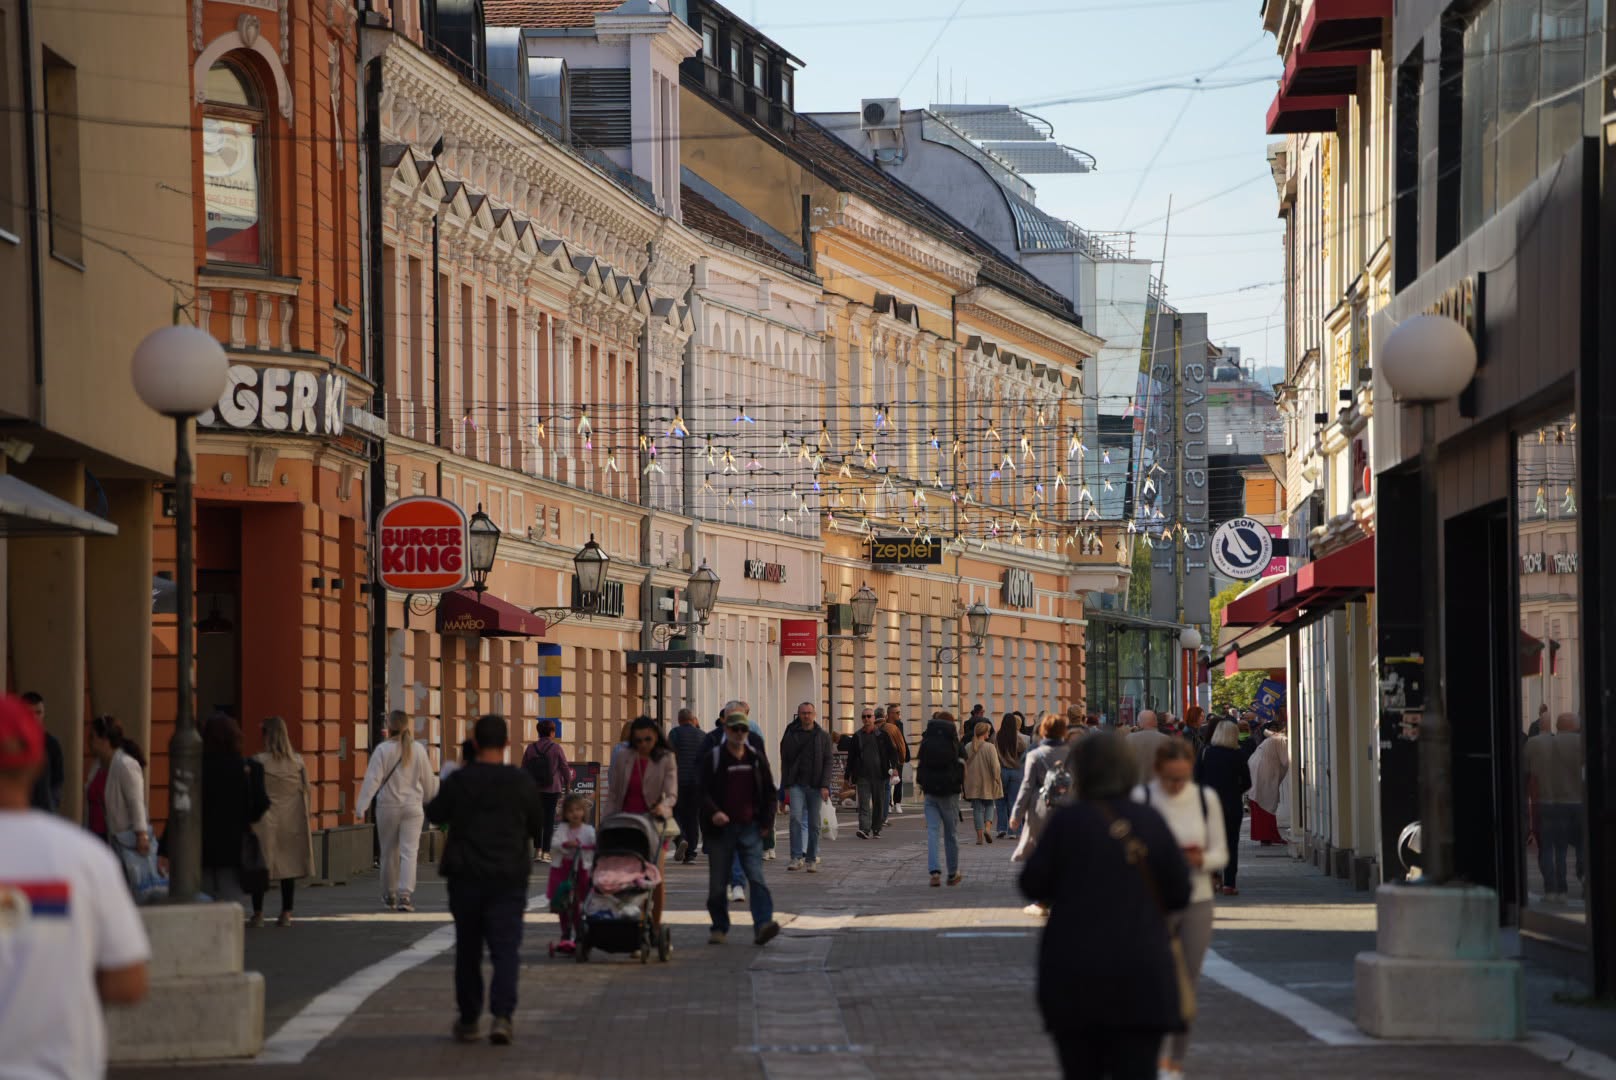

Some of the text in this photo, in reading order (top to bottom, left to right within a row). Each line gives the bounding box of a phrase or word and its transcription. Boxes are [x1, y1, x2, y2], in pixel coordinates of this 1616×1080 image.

[196, 364, 318, 433] GER
[1228, 520, 1255, 529] LEON
[381, 528, 462, 547] BURGER
[381, 547, 463, 572] KING
[444, 619, 485, 630] MAMBO
